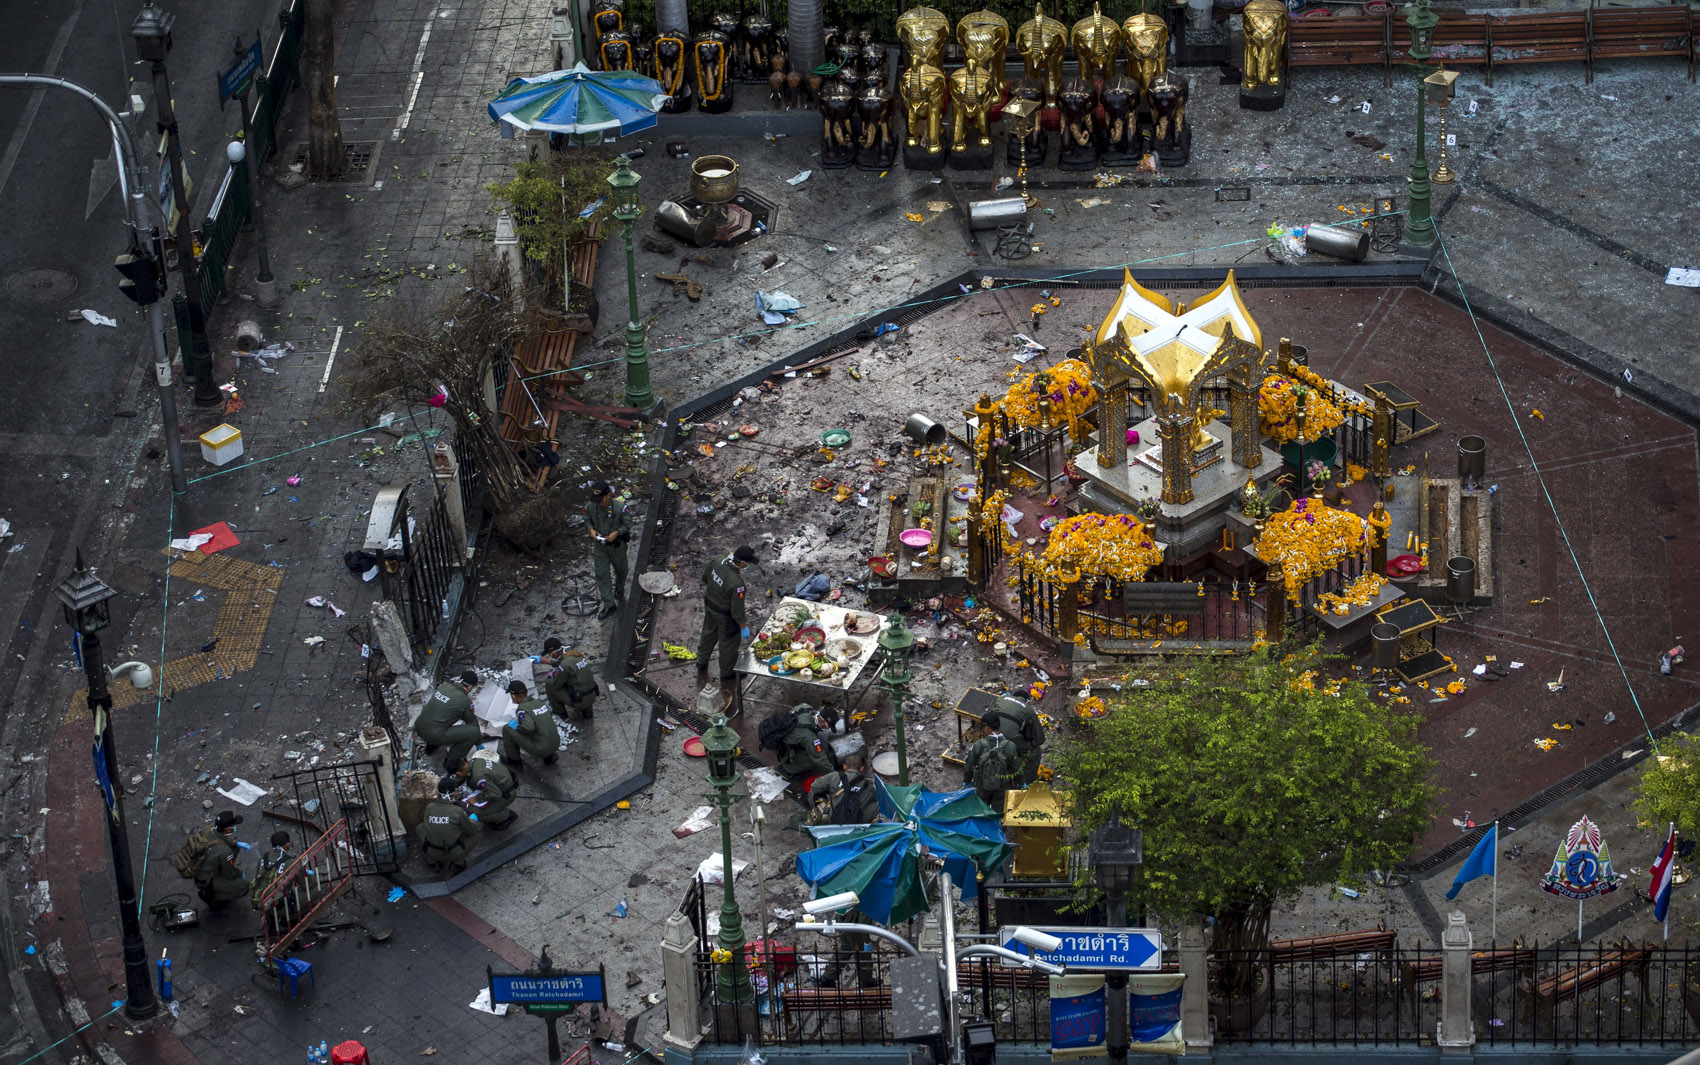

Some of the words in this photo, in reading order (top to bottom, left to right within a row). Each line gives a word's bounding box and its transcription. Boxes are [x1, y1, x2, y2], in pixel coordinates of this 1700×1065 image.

[159, 366, 165, 375] 7
[428, 815, 450, 824] POLICE
[1109, 954, 1129, 963] Rd.
[510, 977, 583, 989] ถนนราชดำริ
